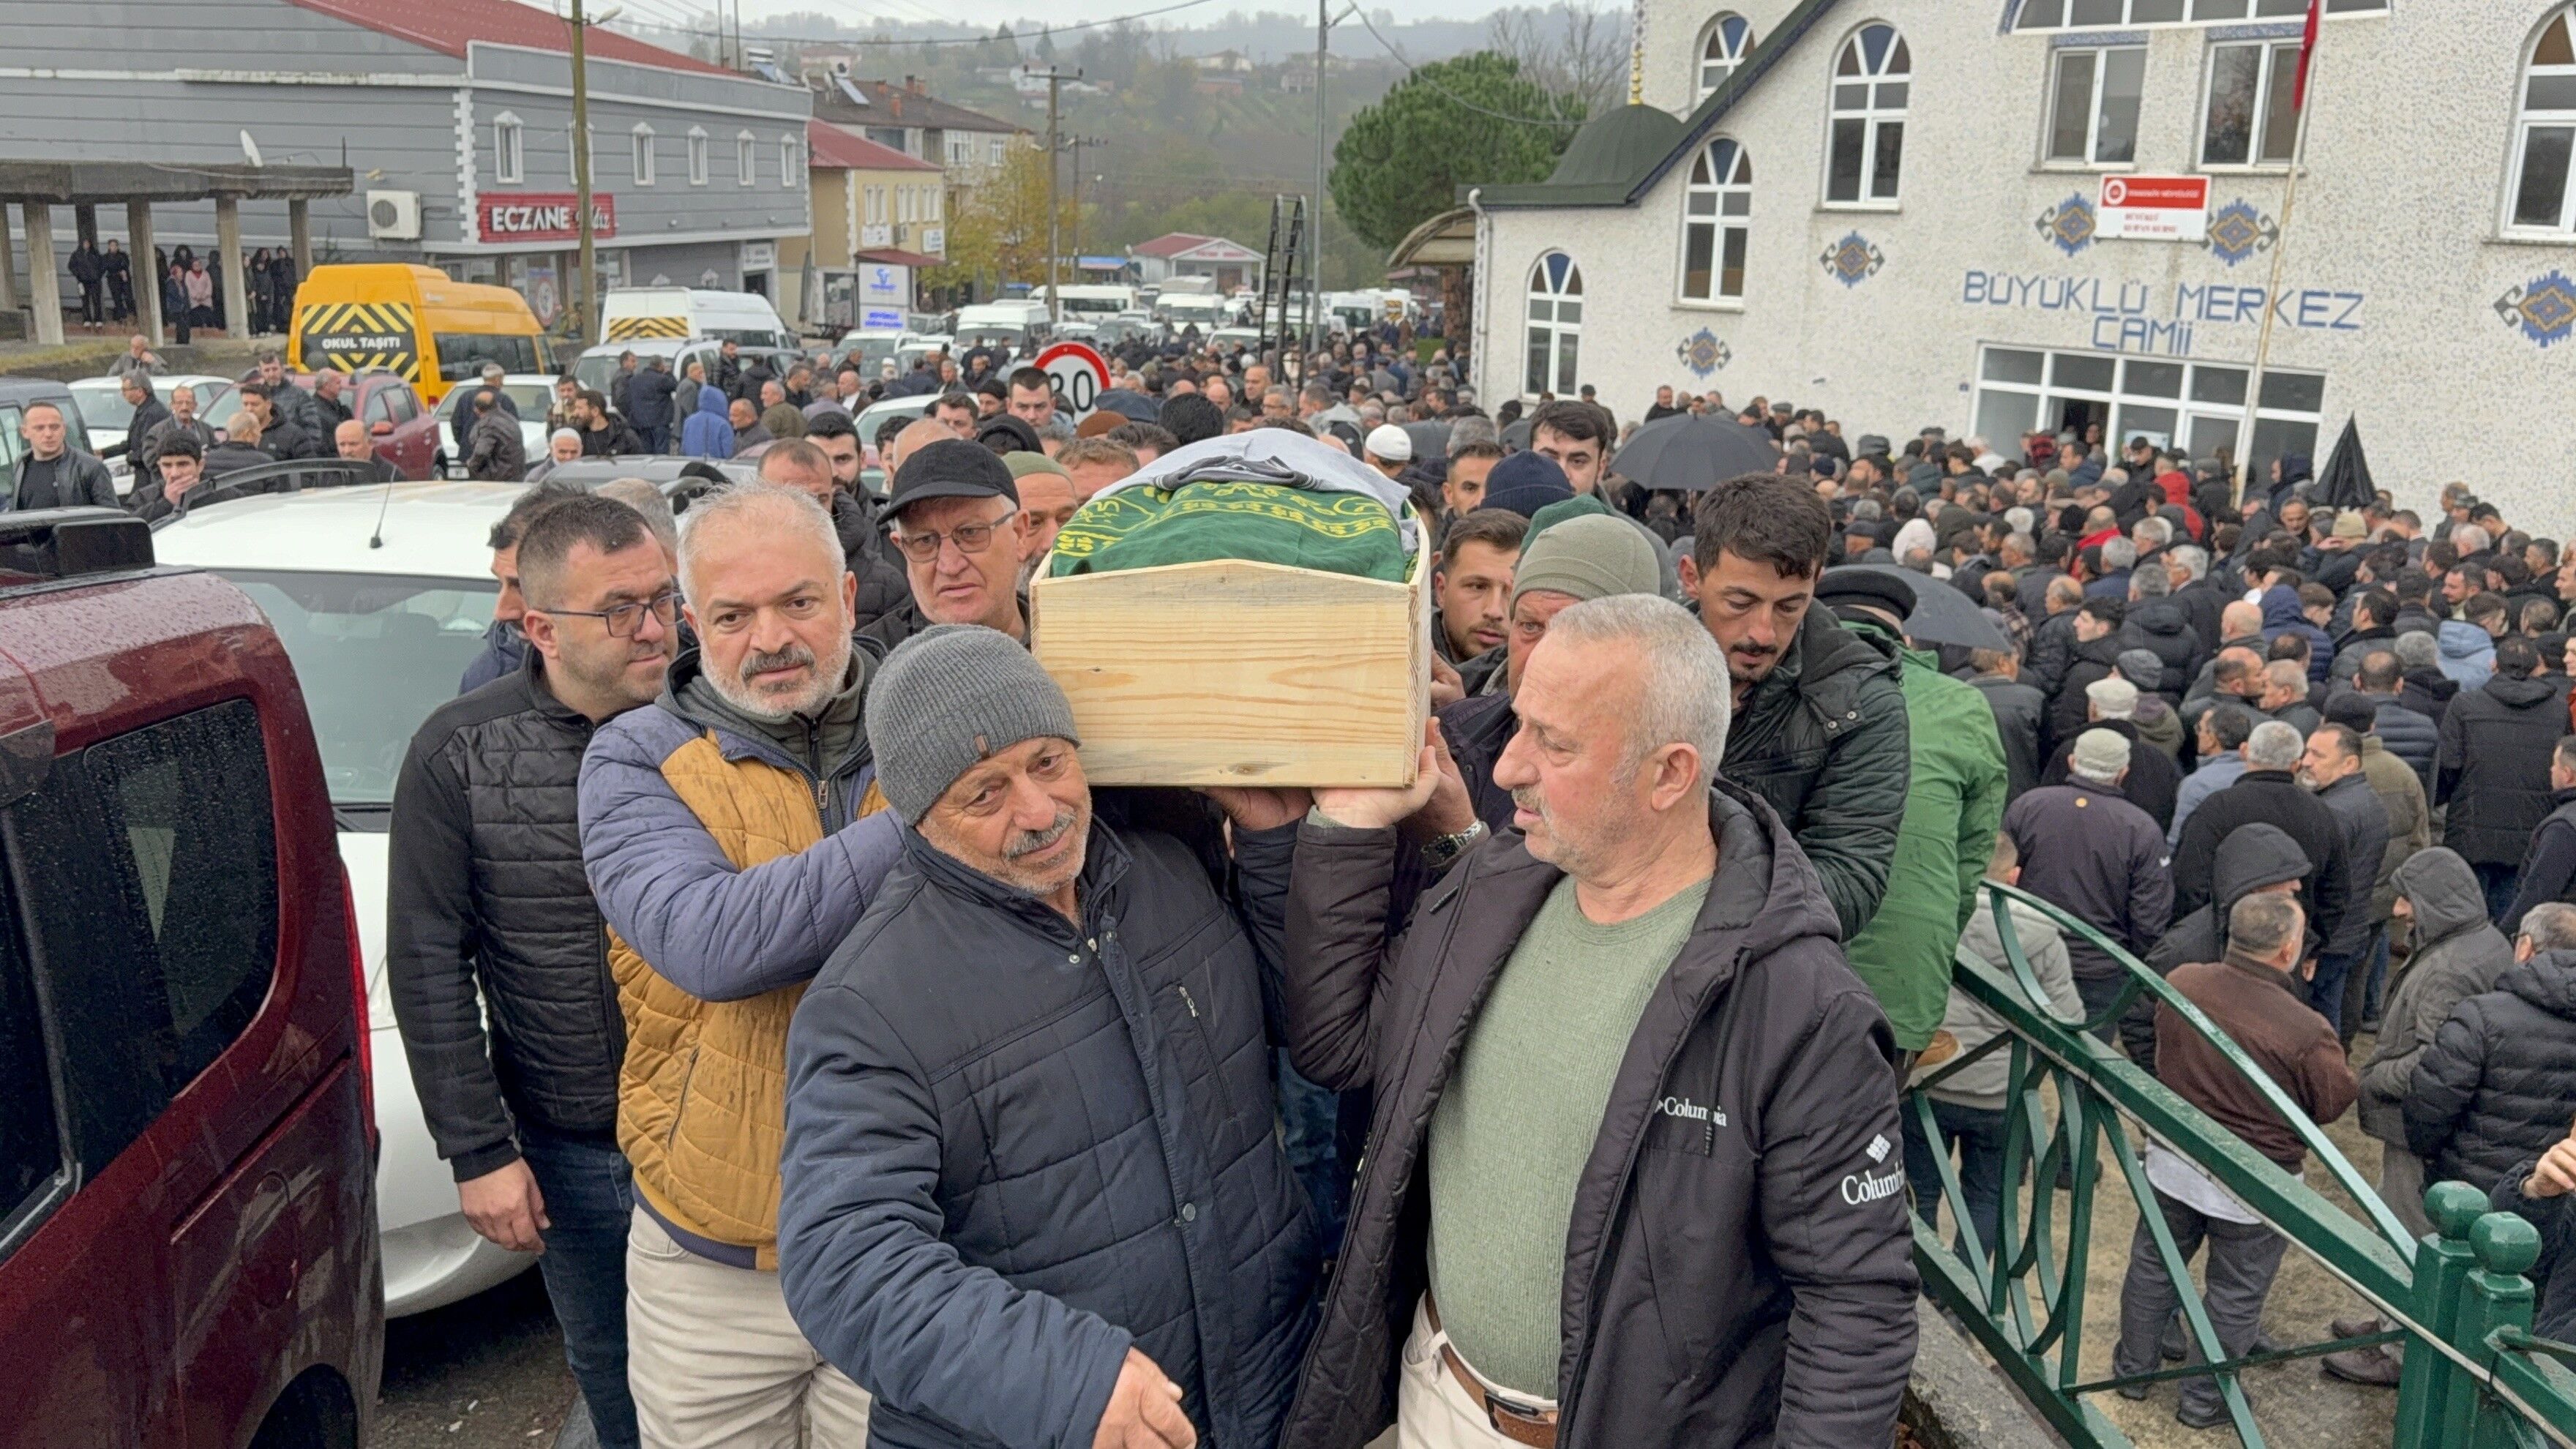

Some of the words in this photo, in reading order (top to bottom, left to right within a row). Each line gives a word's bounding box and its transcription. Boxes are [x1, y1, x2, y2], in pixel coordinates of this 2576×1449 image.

[491, 206, 570, 232] ECZANE
[1963, 270, 2148, 315] BÜYÜKLÜ
[2176, 282, 2364, 329] MERKEZ
[321, 337, 358, 350] OKUL
[359, 337, 401, 351] TAŞITI
[1664, 1096, 1727, 1127] Columia
